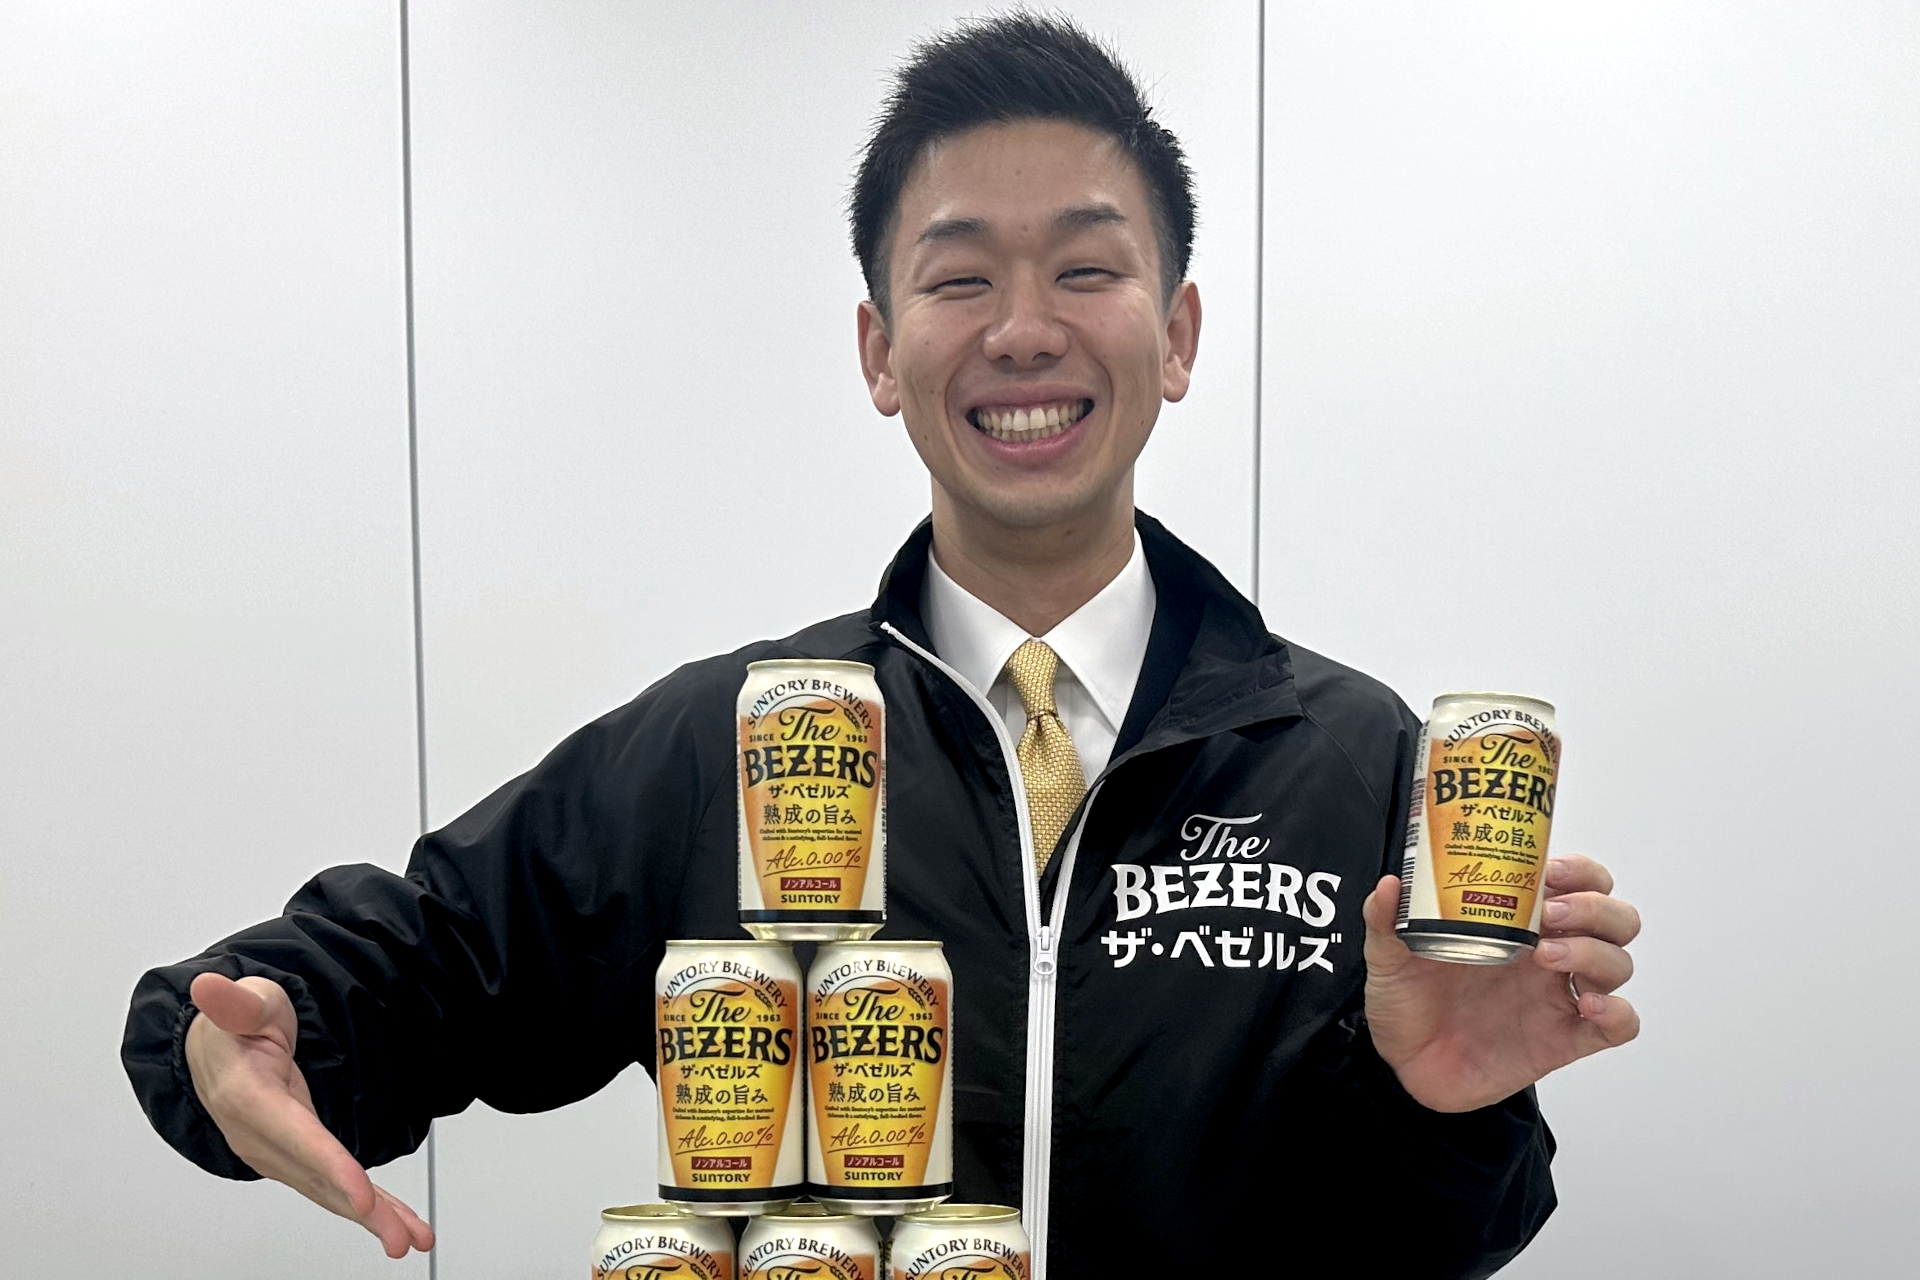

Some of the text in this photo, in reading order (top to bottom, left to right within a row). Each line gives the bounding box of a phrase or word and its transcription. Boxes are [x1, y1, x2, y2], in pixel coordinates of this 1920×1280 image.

[748, 679, 873, 731] SUNTORY BREWERY
[749, 734, 868, 743] SINCE 1963
[778, 706, 841, 741] The
[1443, 709, 1512, 751] SUNTORY
[743, 744, 877, 788] BEZERS
[1443, 756, 1473, 764] SINCE
[1480, 733, 1536, 769] The
[769, 784, 851, 799] ザ・ベゼルズ
[1433, 768, 1556, 819] BEZERS
[764, 804, 857, 825] 熟成の旨み
[1461, 803, 1537, 825] ザ・ベゼルズ
[1180, 812, 1270, 861] The
[1451, 821, 1537, 849] 熟成の旨み
[784, 879, 837, 889] ノンアルコール
[1110, 863, 1342, 928] BEZERS
[1465, 893, 1515, 907] ノンアルコール
[1100, 925, 1342, 973] ザ・ベゼルズ
[662, 961, 788, 1009] SUNTORY BREWERY
[815, 959, 939, 1007] SUNTORY BREWERY
[664, 1014, 781, 1022] SINCE 1963
[690, 989, 751, 1022] The
[816, 1012, 933, 1020] SINCE 1963
[843, 987, 905, 1021] The
[659, 1026, 793, 1066] BEZERS
[811, 1024, 943, 1064] BEZERS
[680, 1064, 763, 1079] ザ・ベゼルズ
[833, 1062, 916, 1077] ザ・ベゼルズ
[675, 1084, 768, 1105] 熟成の旨み
[828, 1082, 920, 1103] 熟成の旨み
[695, 1158, 748, 1168] ノンアルコール
[847, 1156, 900, 1166] ノンアルコール
[657, 1236, 722, 1280] BREWERY
[798, 1237, 864, 1280] BREWERY
